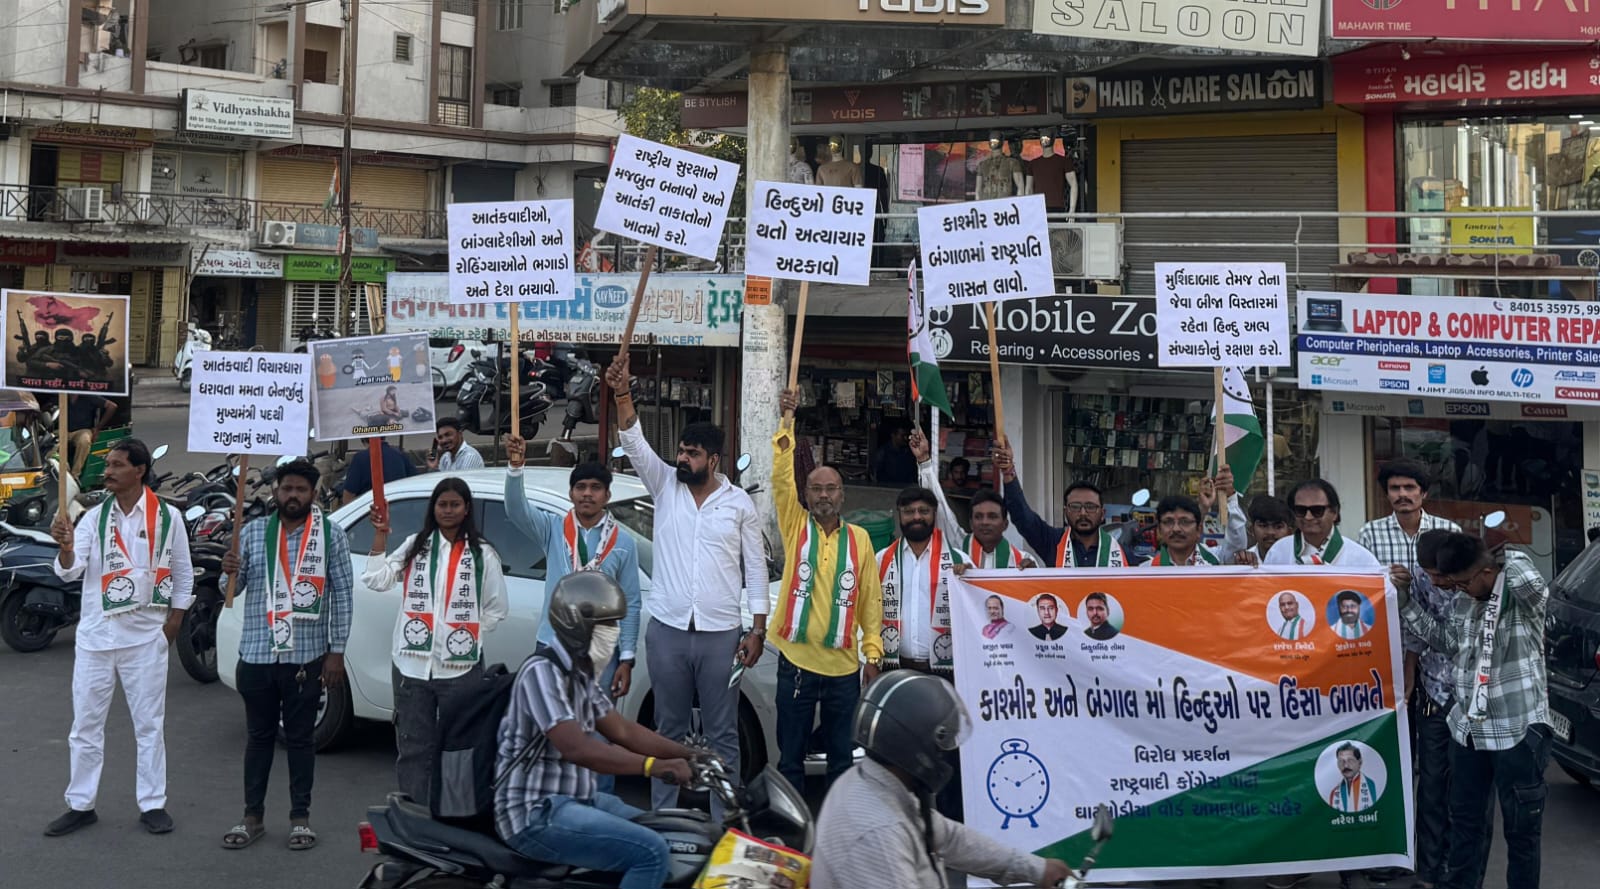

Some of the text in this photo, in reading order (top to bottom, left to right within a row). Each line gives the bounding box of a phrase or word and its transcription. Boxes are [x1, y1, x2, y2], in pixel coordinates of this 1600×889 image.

[1050, 0, 1305, 46] SALOON
[1338, 22, 1411, 31] MAHAVIR TIME
[1100, 69, 1314, 107] HAIR CARE SALOON
[1404, 62, 1567, 96] મહાવીર ટાઈમ
[684, 97, 737, 108] BE STYLISH
[1365, 92, 1397, 100] SONATA
[213, 101, 291, 118] Vidhyashakha
[634, 148, 719, 182] રાષ્ટ્રીય સુરક્ષાને
[614, 166, 725, 208] મજબુત બનાવો અને
[614, 190, 713, 229] આતંકી તાકાતોનો
[765, 188, 864, 218] હિન્દુઓ ઉપર
[472, 208, 551, 225] આતંકવાદીઓ,
[942, 203, 1020, 232] કાશ્મીર અને
[461, 229, 564, 251] બાંગ્લાદેશીઓ અને
[623, 217, 687, 247] ખાતમો કરો.
[756, 219, 866, 247] થતો અત્યાચાર
[928, 235, 1042, 267] બંગાળમાં રાષ્ટ્રપતિ
[456, 252, 569, 275] રોહિંગ્યાઓને ભગાડો
[775, 254, 839, 277] અટકાવો
[465, 278, 559, 298] અને દેશ બચાવો.
[948, 270, 1028, 299] શાસન લાવો.
[1165, 267, 1280, 290] મુર્શિદાબાદ તેમજ તેના
[1169, 293, 1278, 309] જેવા બીજા વિસ્તારમાં
[1510, 301, 1544, 313] 84015
[969, 300, 1096, 335] Mobile
[1180, 316, 1270, 337] રહેતા હિન્દુ અલ્પ
[1352, 309, 1422, 336] LAPTOP
[1427, 311, 1442, 337] &
[1447, 312, 1551, 342] COMPUTER
[576, 332, 703, 345] ENGLISH MDIUM NCERT
[1306, 336, 1354, 352] Computer
[1357, 341, 1423, 356] Pheripherals,
[1425, 343, 1461, 358] Laptop
[1466, 344, 1534, 361] Accessories,
[1536, 347, 1573, 361] Printer
[971, 340, 1141, 362] Rearing Accessories
[1168, 339, 1282, 361] સંખ્યાકોનું રક્ષણ કરો.
[203, 357, 303, 374] આતંકવાદી વિચારધારા
[1310, 355, 1596, 379] acer Lenovo ASUS
[22, 377, 41, 386] जात
[1323, 376, 1408, 389] Microsoft EPSON
[1512, 368, 1532, 387] hp
[199, 380, 304, 402] ધરાવતા મમતા બેનર્જીનું
[1477, 389, 1495, 397] INFO
[1496, 390, 1541, 399] MULTI-TECH
[1557, 388, 1599, 399] Canon
[216, 404, 284, 424] મુખ્યમંત્રી પદથી
[1446, 404, 1488, 415] EPSON
[1523, 405, 1566, 416] Canon
[213, 430, 282, 448] રાજીનામું આપો.
[353, 422, 404, 434] Dharm pucha
[979, 667, 1384, 732] કાશ્મીર અને બંગાલ માં હિન્દુઓ પર હિંસા બાબતે
[1134, 745, 1231, 764] વિરોધ પ્રદર્શન
[1110, 772, 1169, 796] રાષ્ટ્રવાદી
